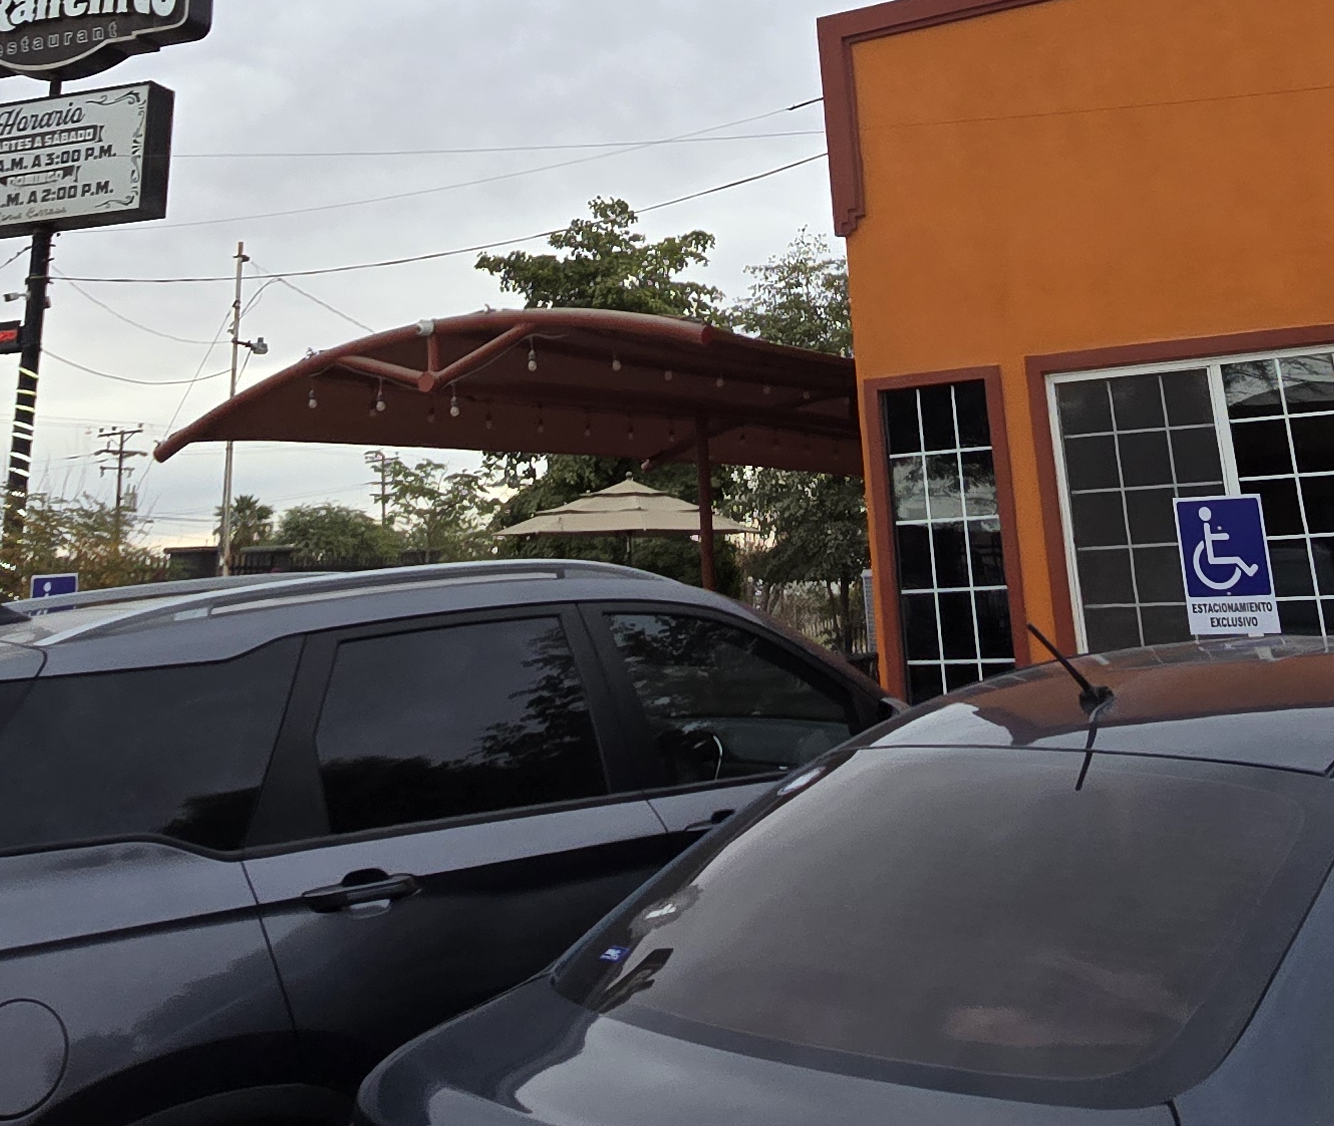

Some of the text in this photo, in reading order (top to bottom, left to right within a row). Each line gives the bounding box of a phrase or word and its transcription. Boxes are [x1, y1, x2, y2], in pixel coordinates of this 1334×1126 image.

[33, 138, 42, 148] A
[44, 128, 94, 146] SÁBADO
[31, 154, 42, 168] A
[45, 148, 81, 166] 3:00
[84, 144, 117, 161] P.M.
[27, 190, 37, 204] A
[42, 184, 78, 202] 2:00
[81, 180, 114, 197] P.M.
[1192, 602, 1272, 613] ESTACIONAMIENTO
[1210, 617, 1258, 627] EXCLUSIVO
